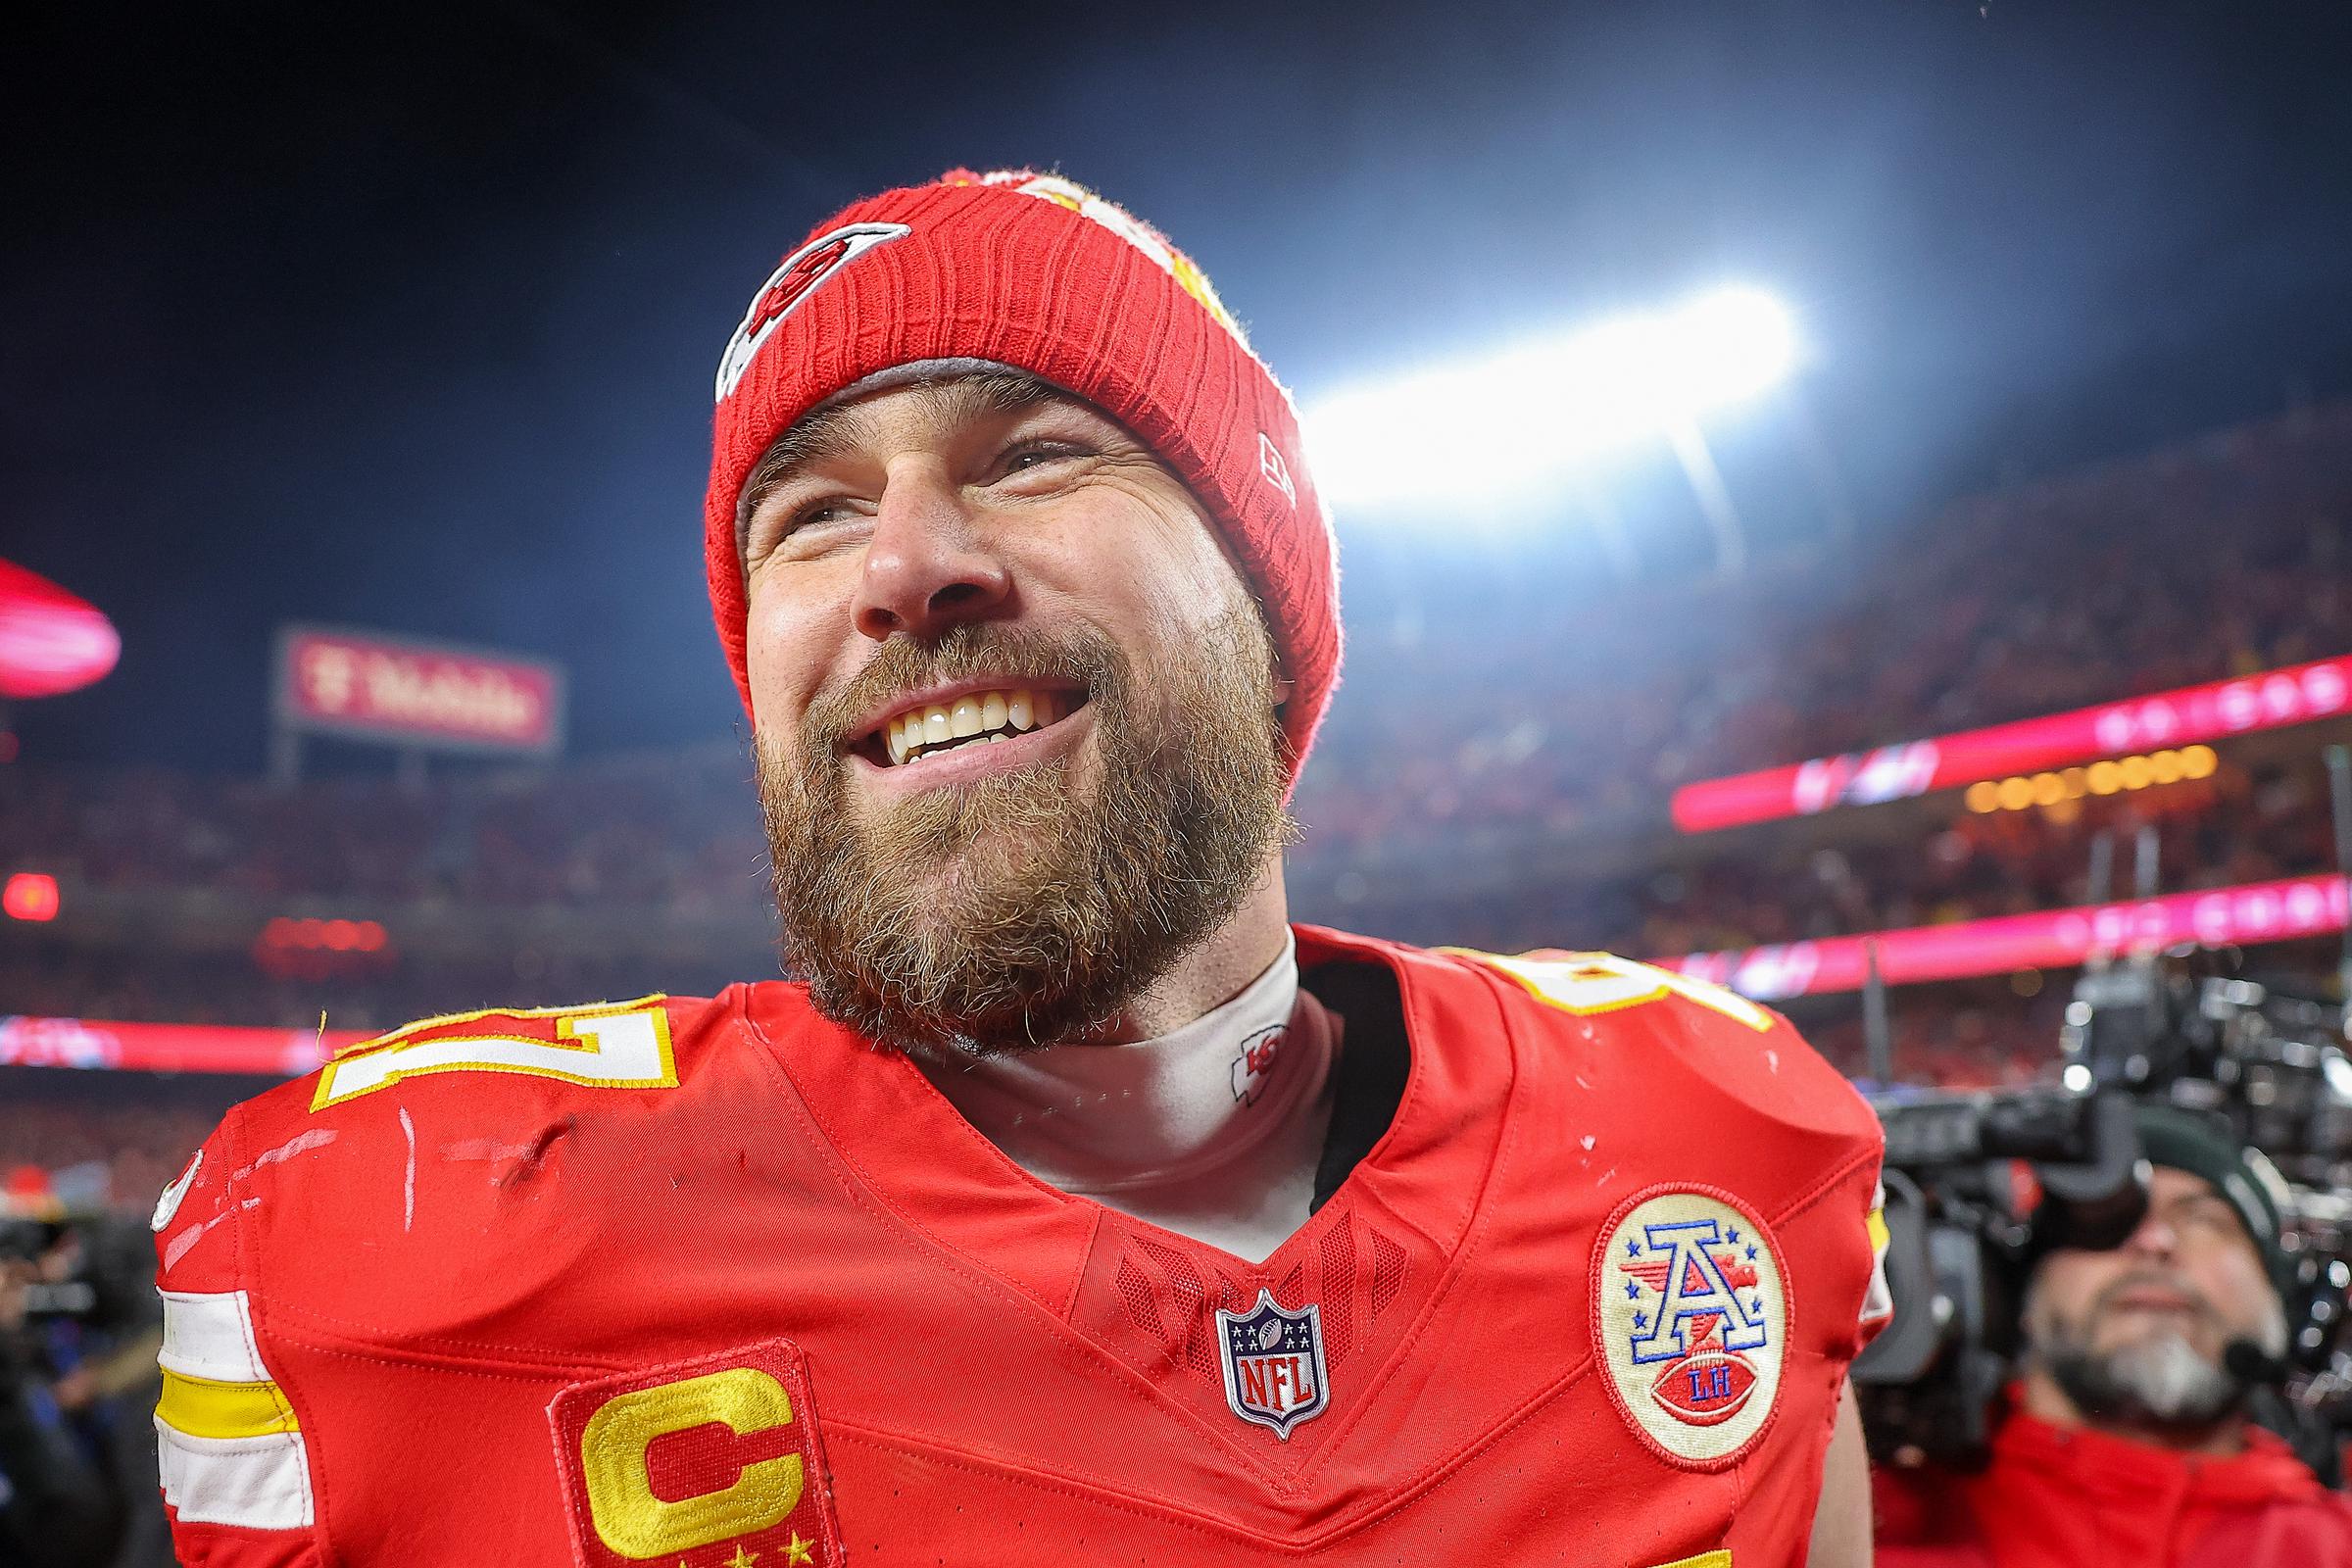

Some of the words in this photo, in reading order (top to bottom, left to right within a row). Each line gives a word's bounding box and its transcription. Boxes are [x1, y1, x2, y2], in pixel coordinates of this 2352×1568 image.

[1631, 1219, 1766, 1364] A
[1240, 1356, 1311, 1411] NFL
[1689, 1366, 1731, 1401] LH
[581, 1367, 804, 1560] C
